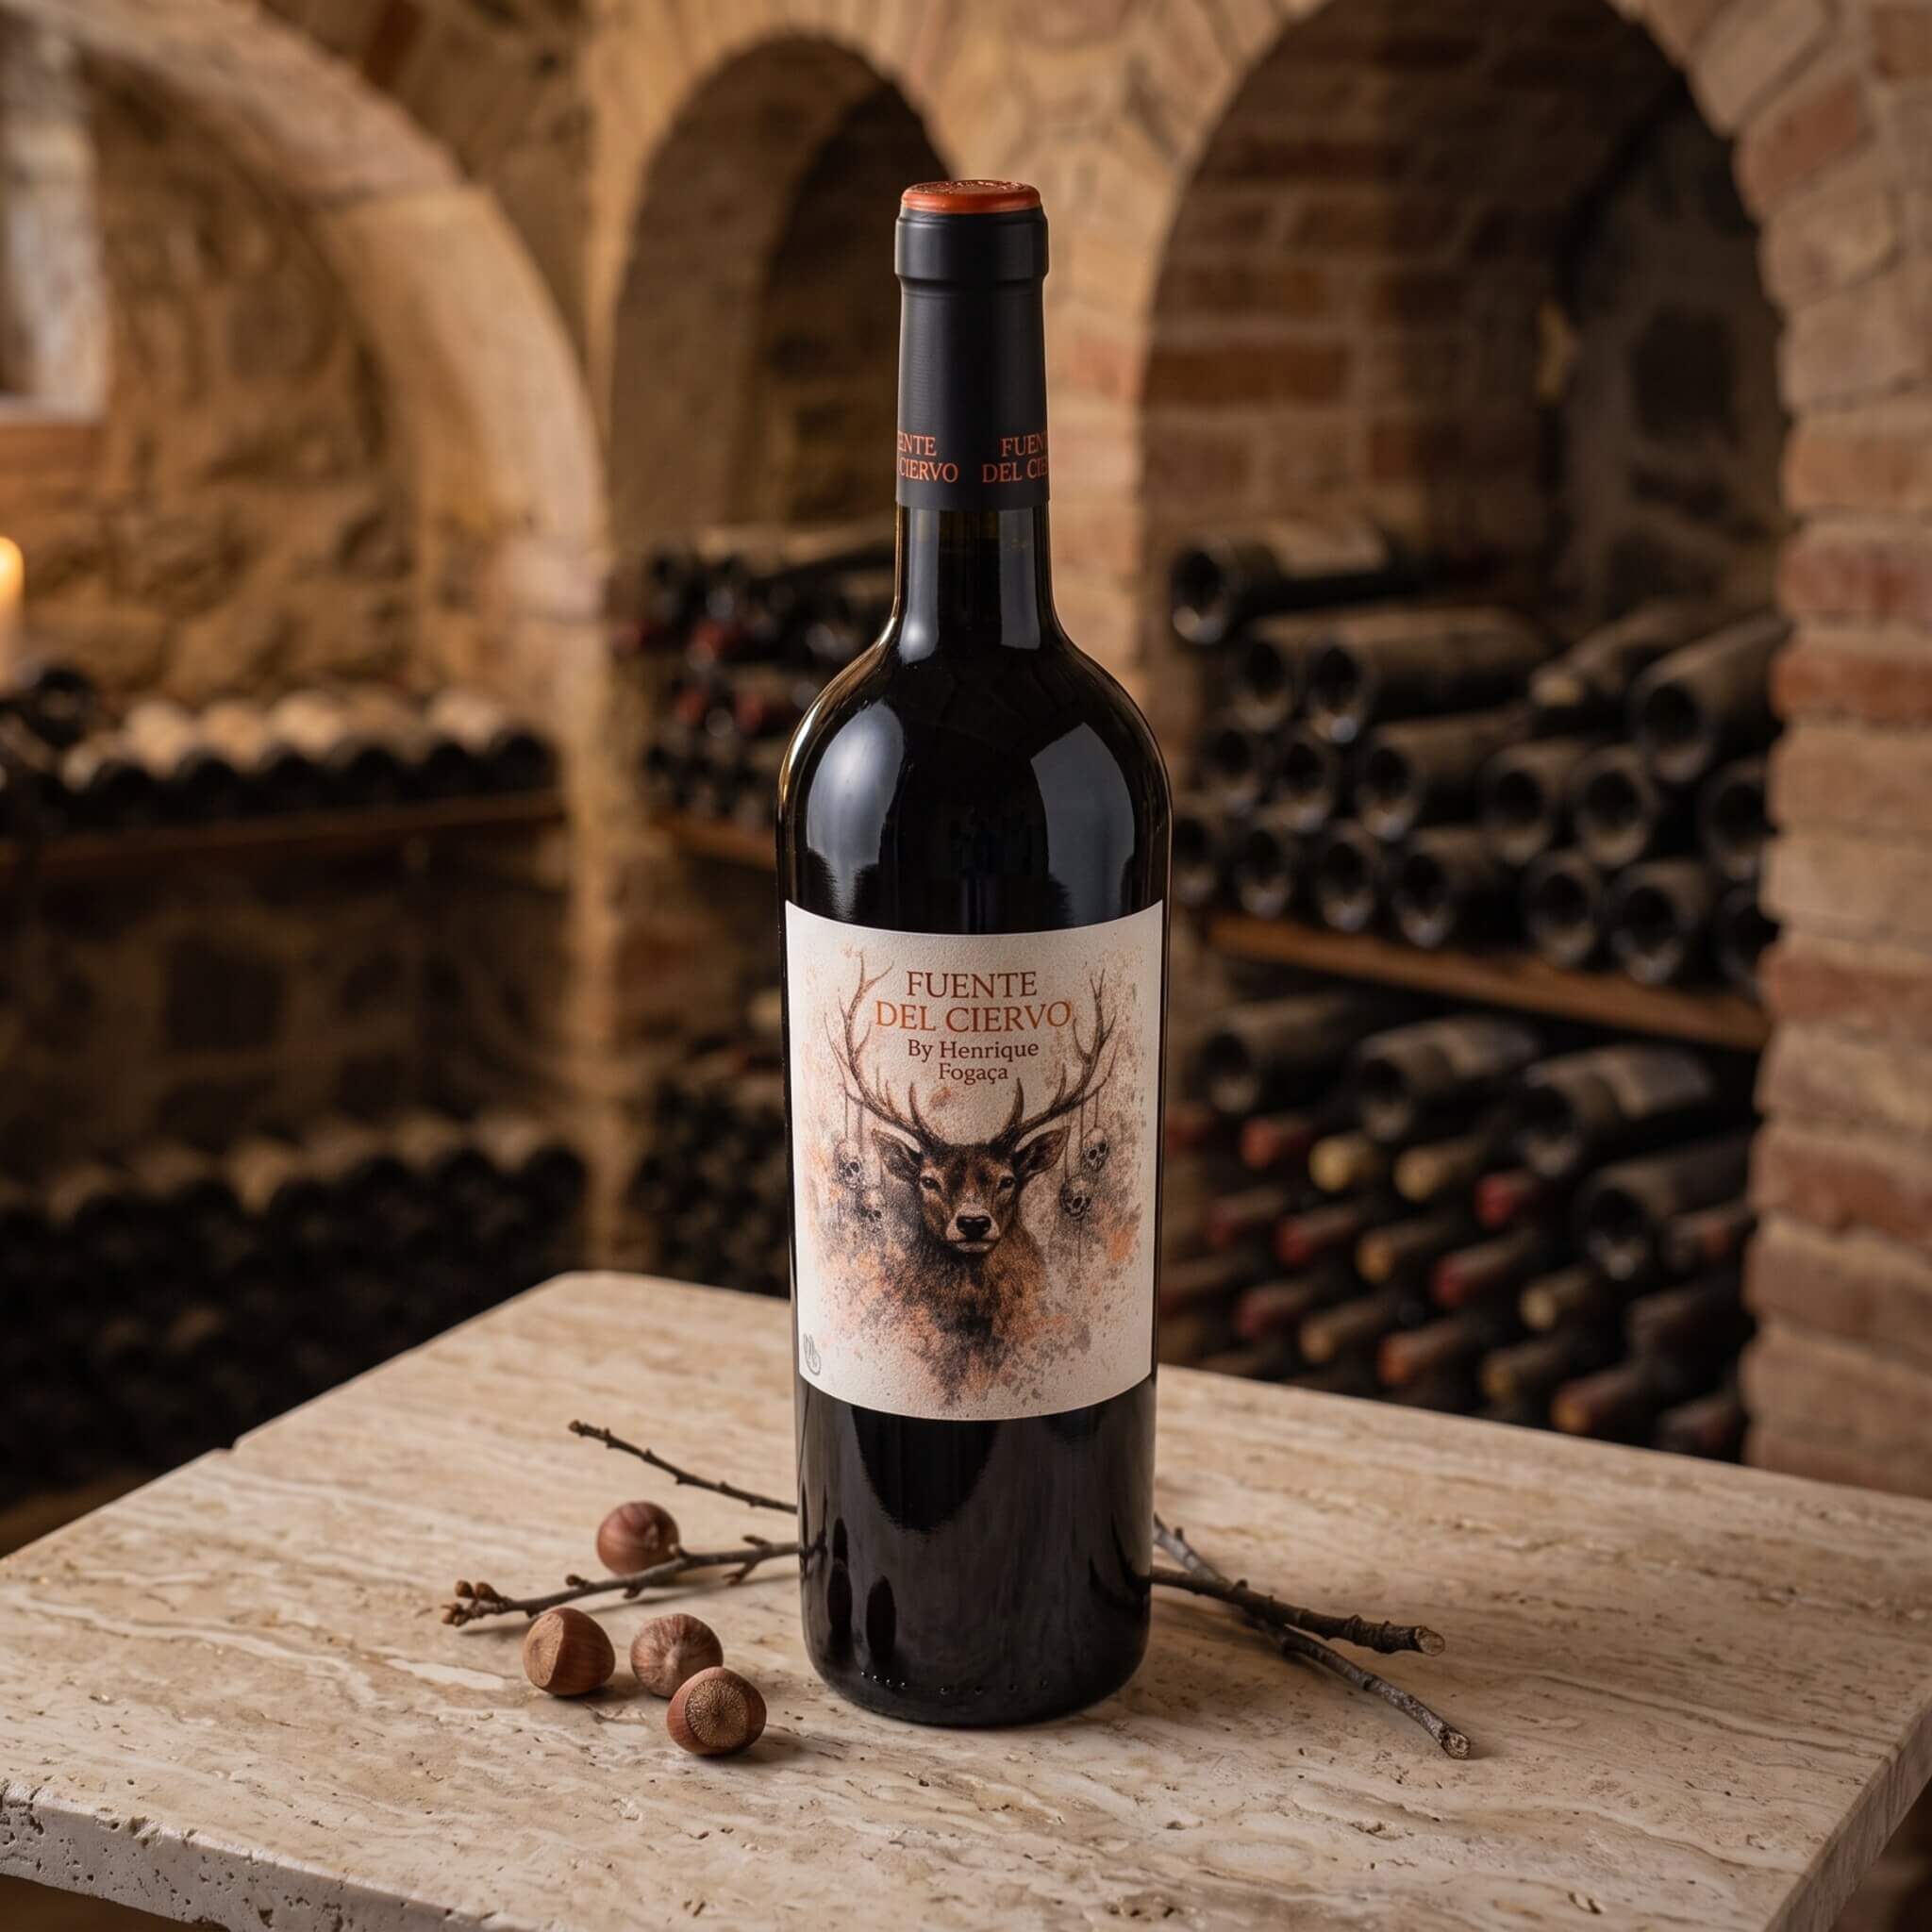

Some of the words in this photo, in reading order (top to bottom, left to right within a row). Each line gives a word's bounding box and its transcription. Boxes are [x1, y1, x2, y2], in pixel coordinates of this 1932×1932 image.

[898, 457, 959, 483] CIERVO
[982, 463, 1023, 483] DEL
[907, 971, 1037, 998] FUENTE
[875, 1000, 936, 1031] DEL
[946, 1001, 1073, 1032] CIERVO
[908, 1040, 933, 1062] By
[940, 1041, 1039, 1062] Henrique
[939, 1063, 1008, 1085] Fogaça
